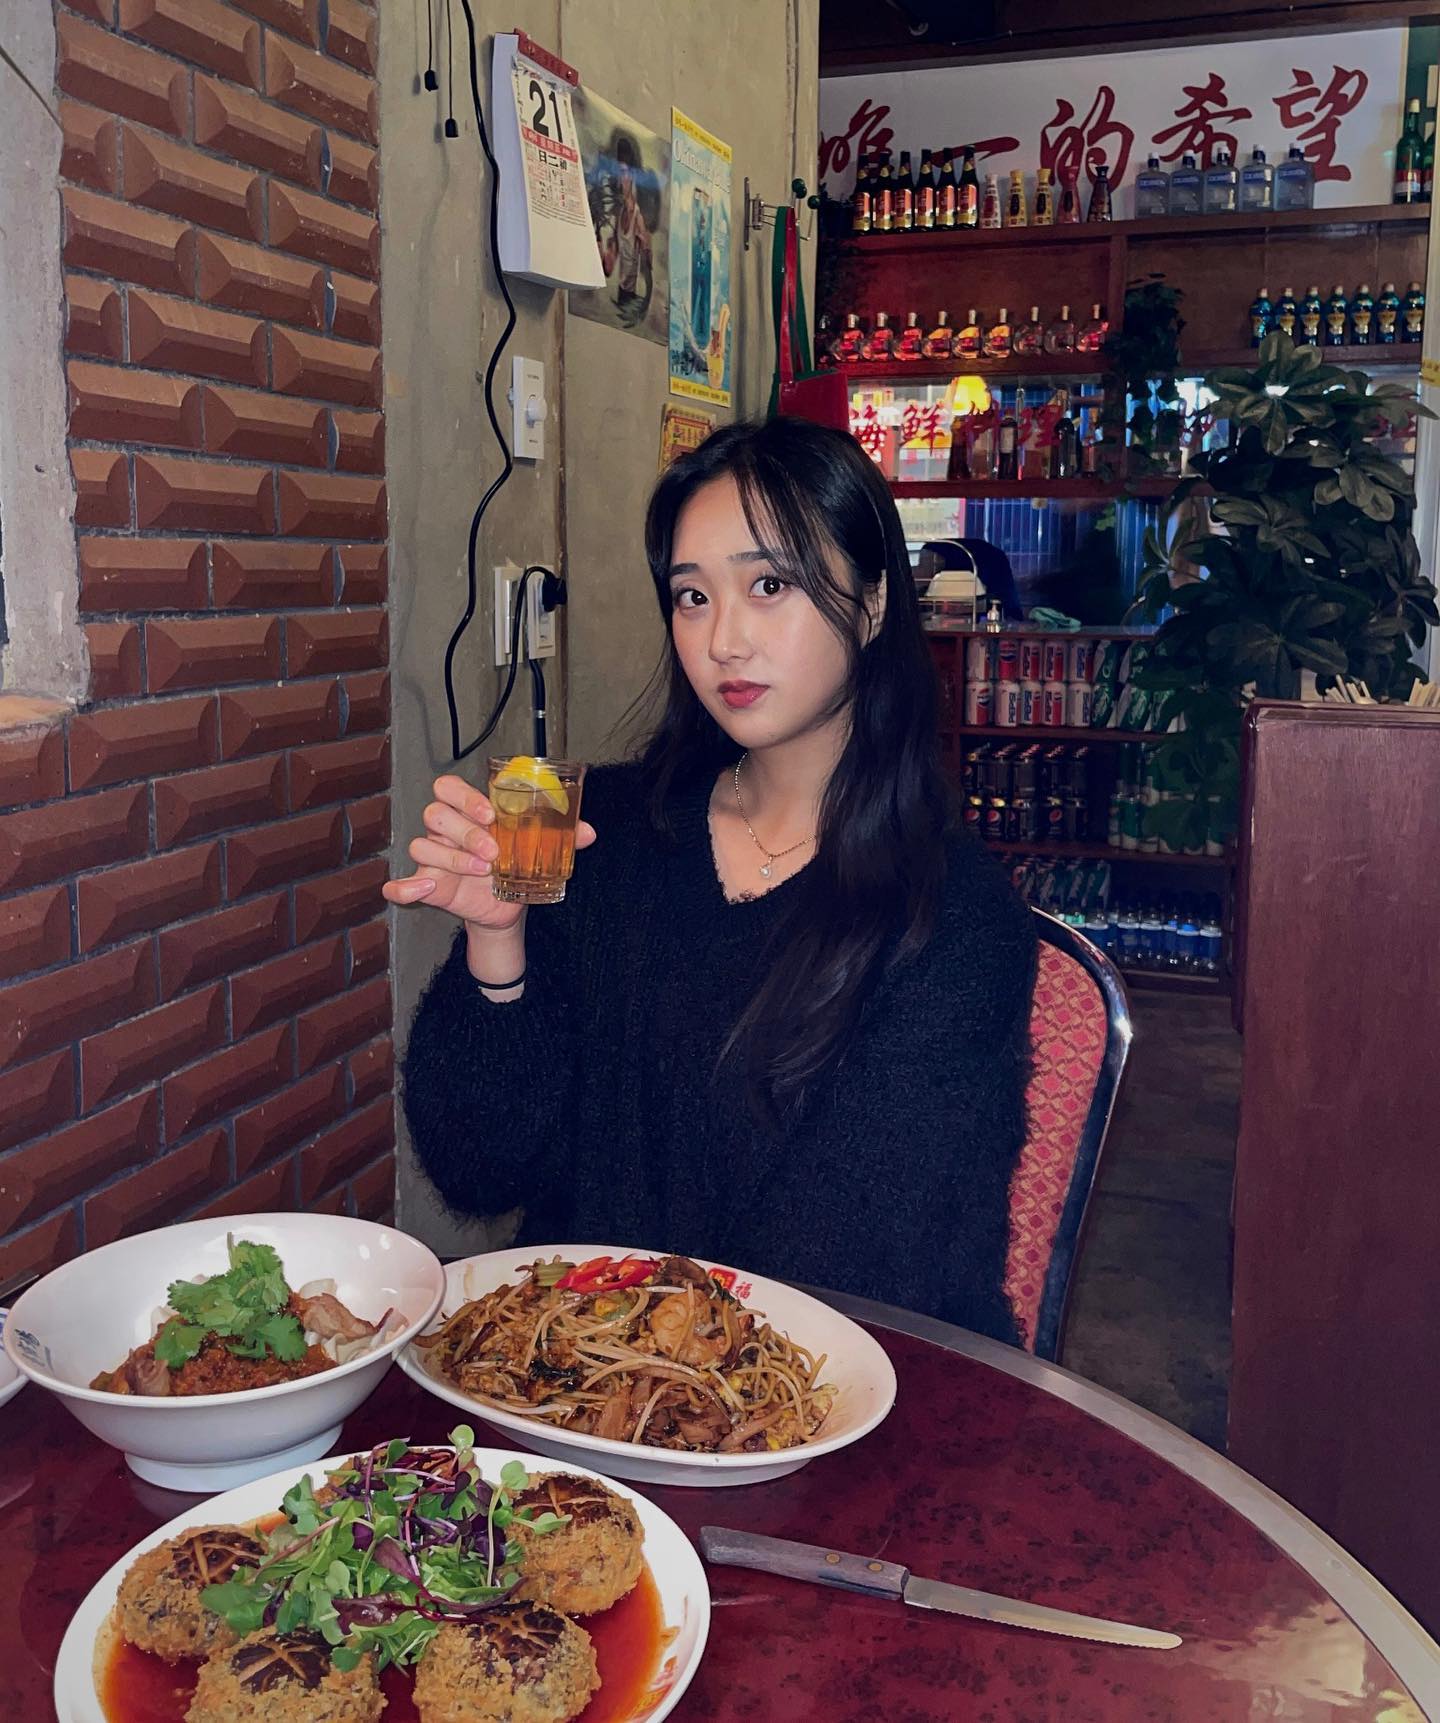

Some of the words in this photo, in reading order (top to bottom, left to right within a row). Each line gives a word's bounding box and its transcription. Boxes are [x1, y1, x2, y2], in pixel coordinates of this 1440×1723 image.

[529, 80, 563, 143] 21
[820, 65, 1369, 189] 唯一的希望
[1008, 692, 1016, 723] PEPSI
